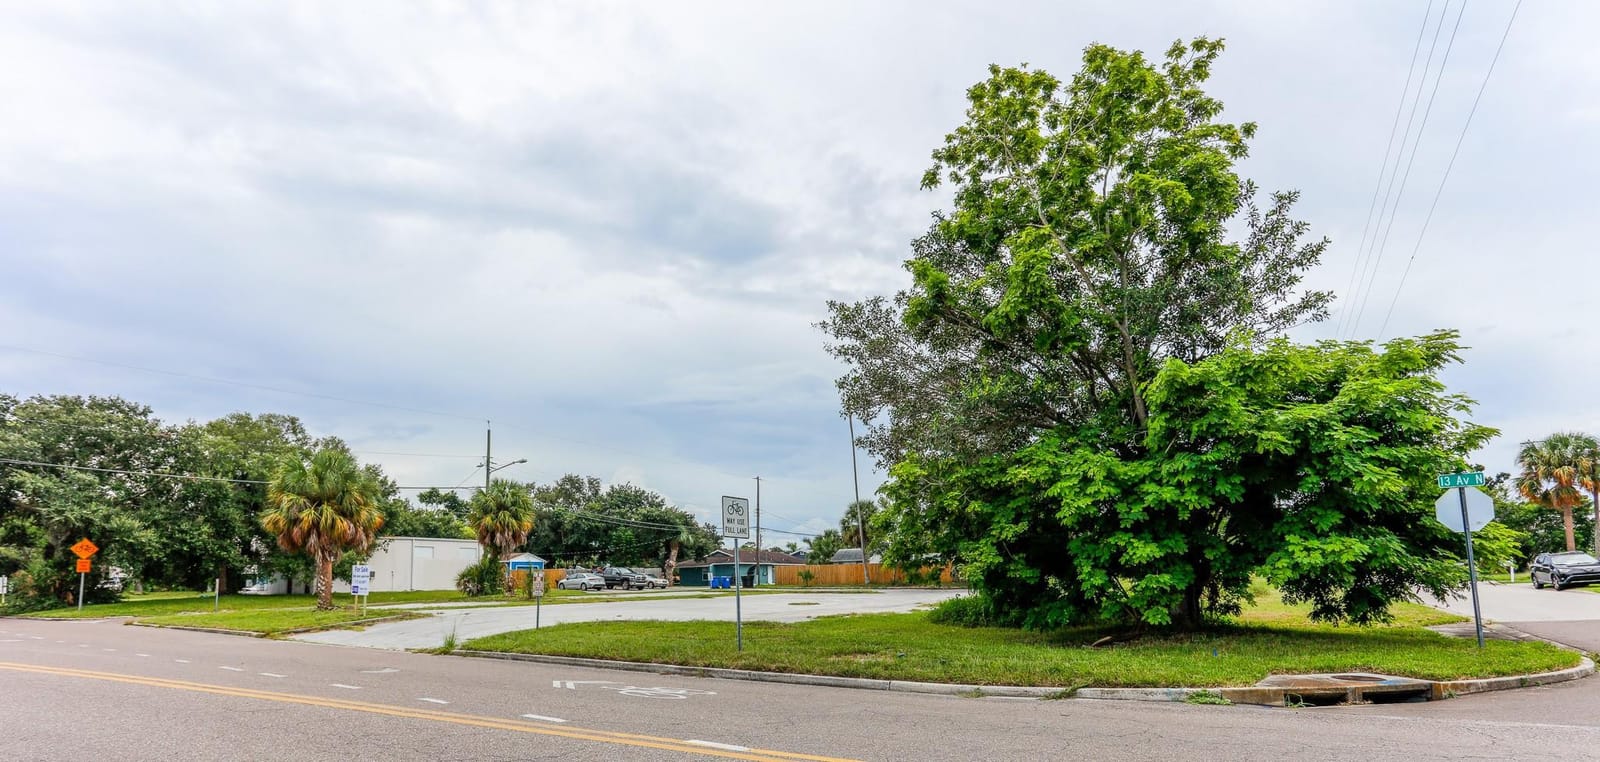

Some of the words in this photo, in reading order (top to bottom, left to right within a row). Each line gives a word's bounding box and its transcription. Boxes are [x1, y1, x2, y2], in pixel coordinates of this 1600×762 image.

[1440, 476, 1450, 486] 13
[1456, 475, 1469, 485] Av
[1475, 474, 1482, 483] N
